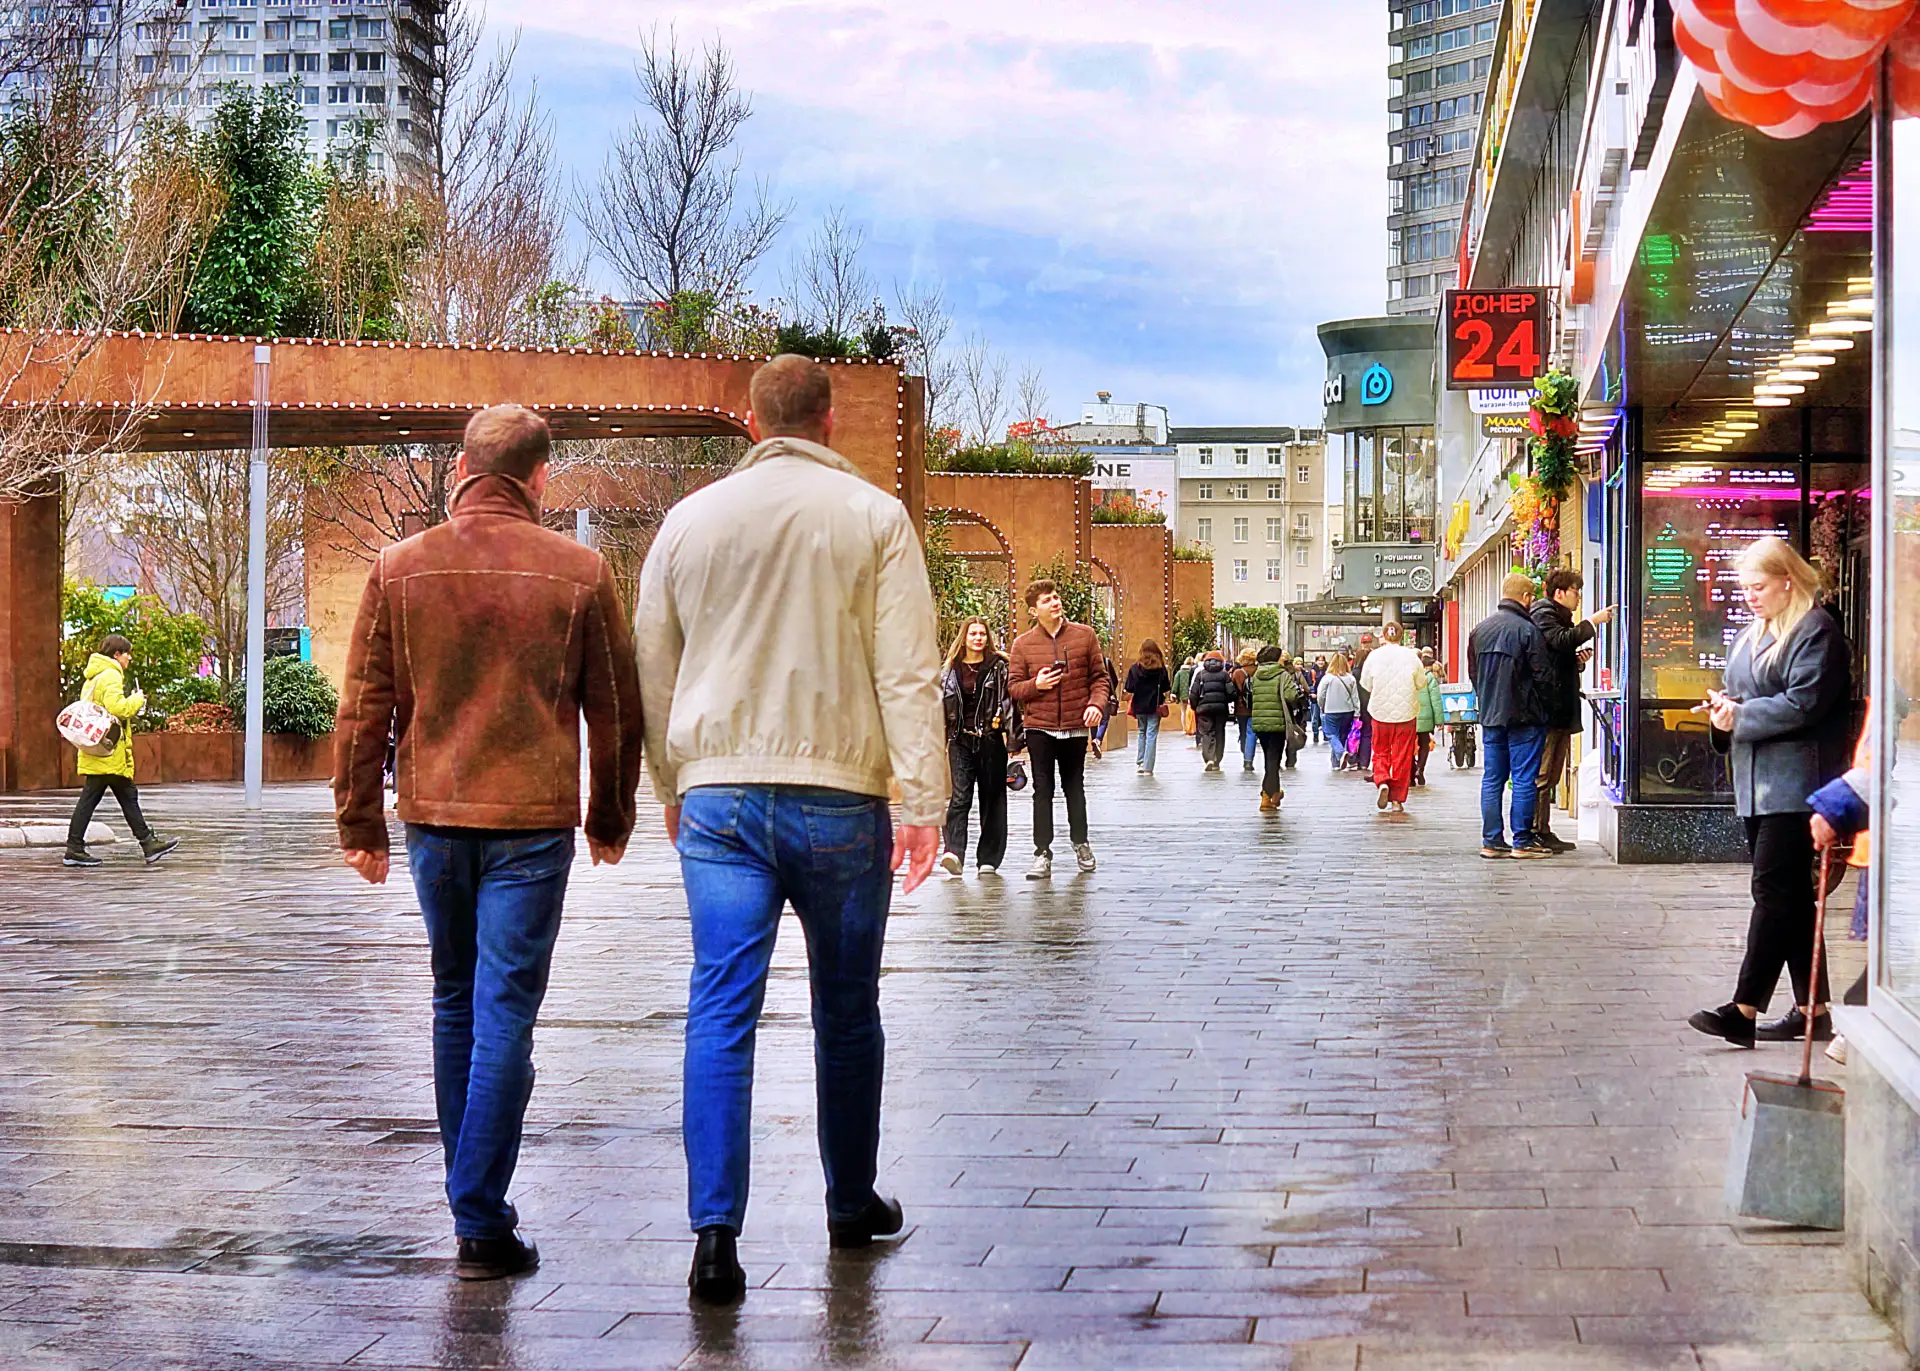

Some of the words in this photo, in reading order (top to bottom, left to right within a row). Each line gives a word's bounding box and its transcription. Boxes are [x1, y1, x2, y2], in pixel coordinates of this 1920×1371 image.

[1453, 294, 1536, 318] ДОНЕР
[1453, 319, 1540, 378] 24
[1087, 463, 1131, 477] NE
[1383, 554, 1423, 563] наушники
[1383, 568, 1407, 577] аудио
